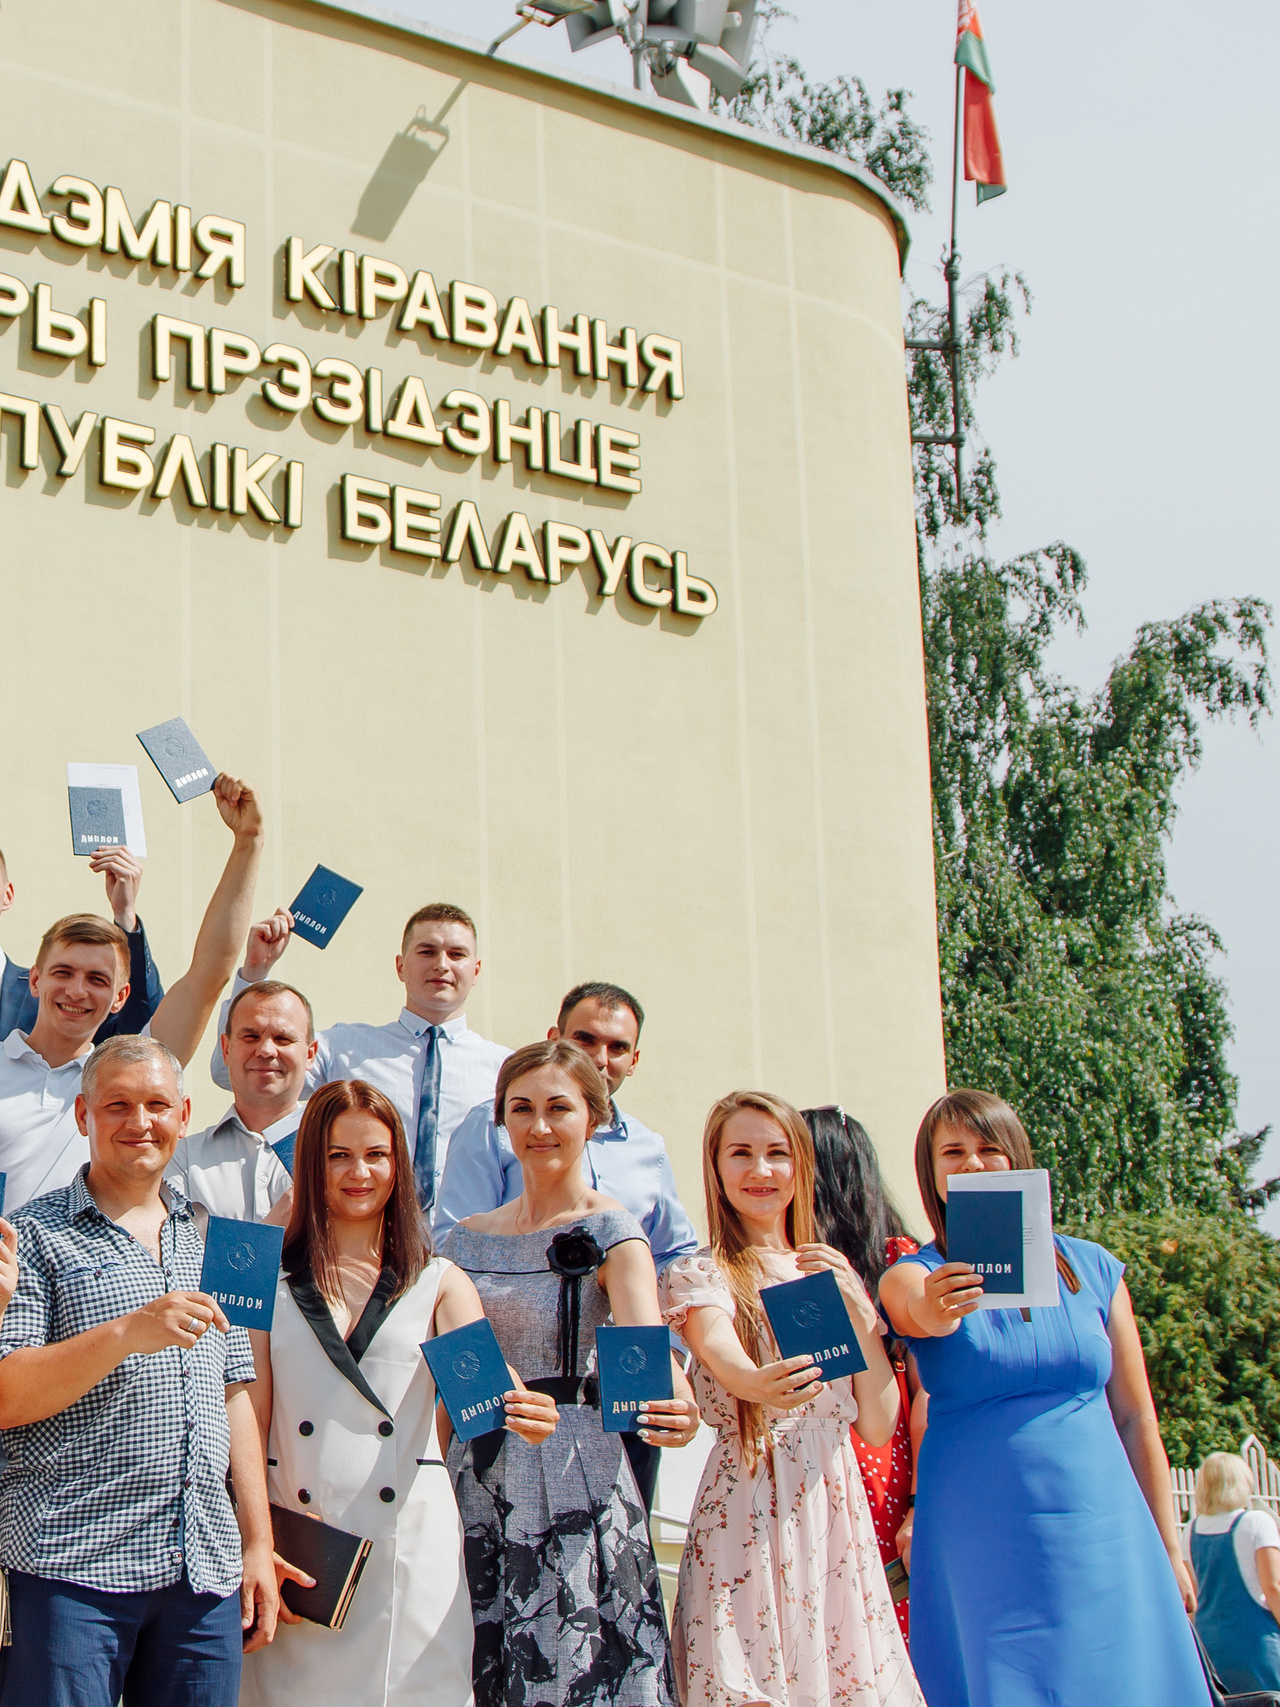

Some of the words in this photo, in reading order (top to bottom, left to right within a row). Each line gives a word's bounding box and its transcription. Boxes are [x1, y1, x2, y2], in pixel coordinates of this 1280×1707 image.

[284, 235, 685, 400] КІРАВАННЯ
[151, 313, 643, 494] ПРЭЗІДЭНЦЕ
[340, 473, 719, 619] БЕЛАРУСЬ
